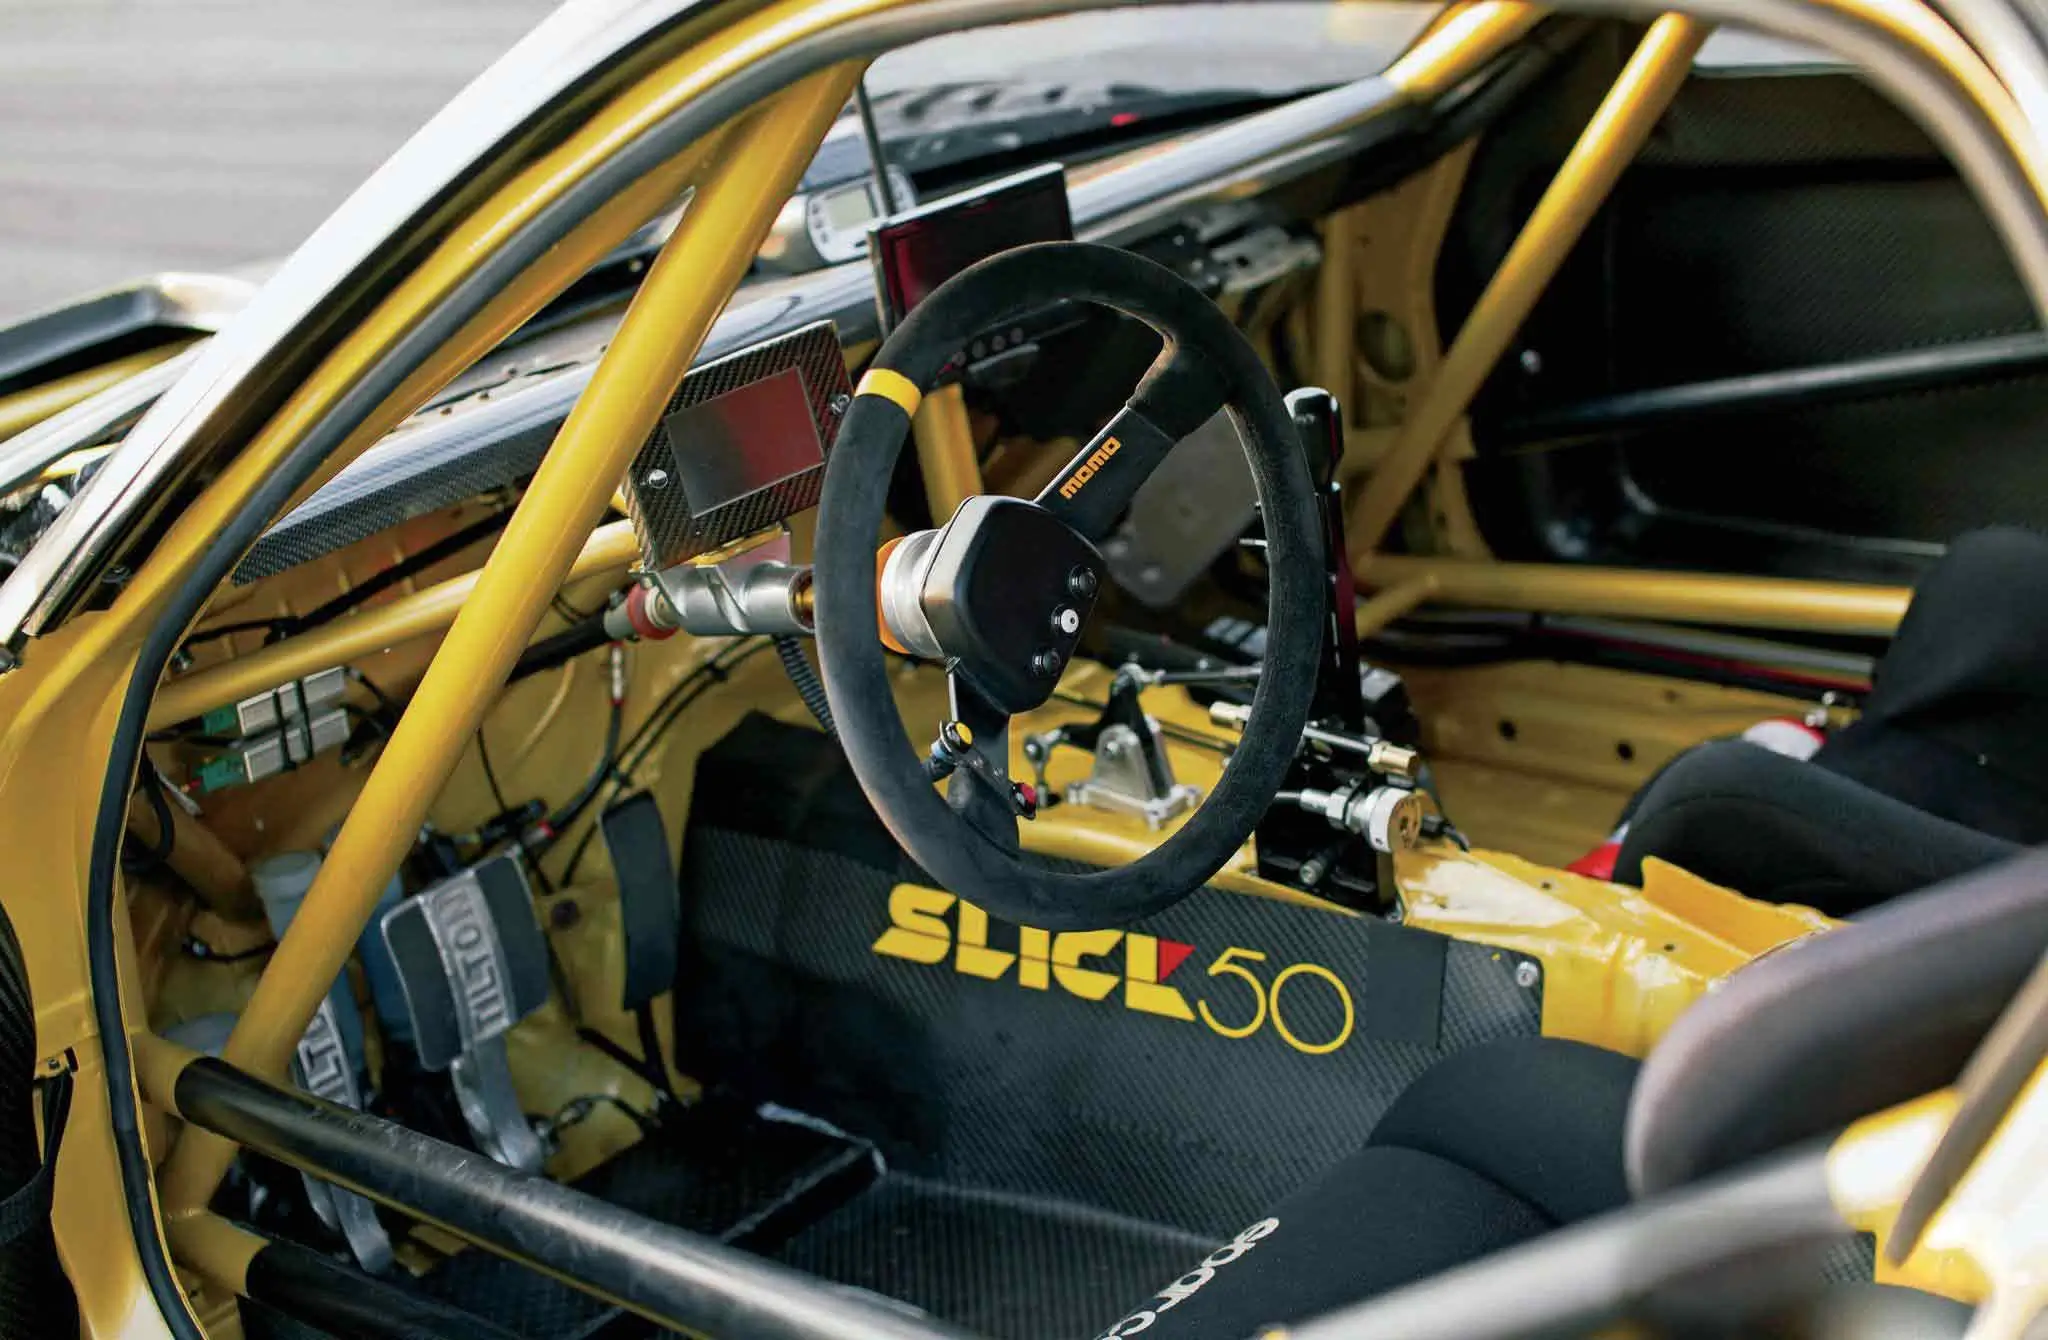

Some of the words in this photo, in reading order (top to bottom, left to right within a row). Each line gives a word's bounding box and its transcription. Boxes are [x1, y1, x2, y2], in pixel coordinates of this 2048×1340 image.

[434, 887, 505, 1033] TILTON
[872, 882, 1197, 1022] SLICK
[1199, 946, 1355, 1054] 50
[1097, 1217, 1280, 1340] sparc
